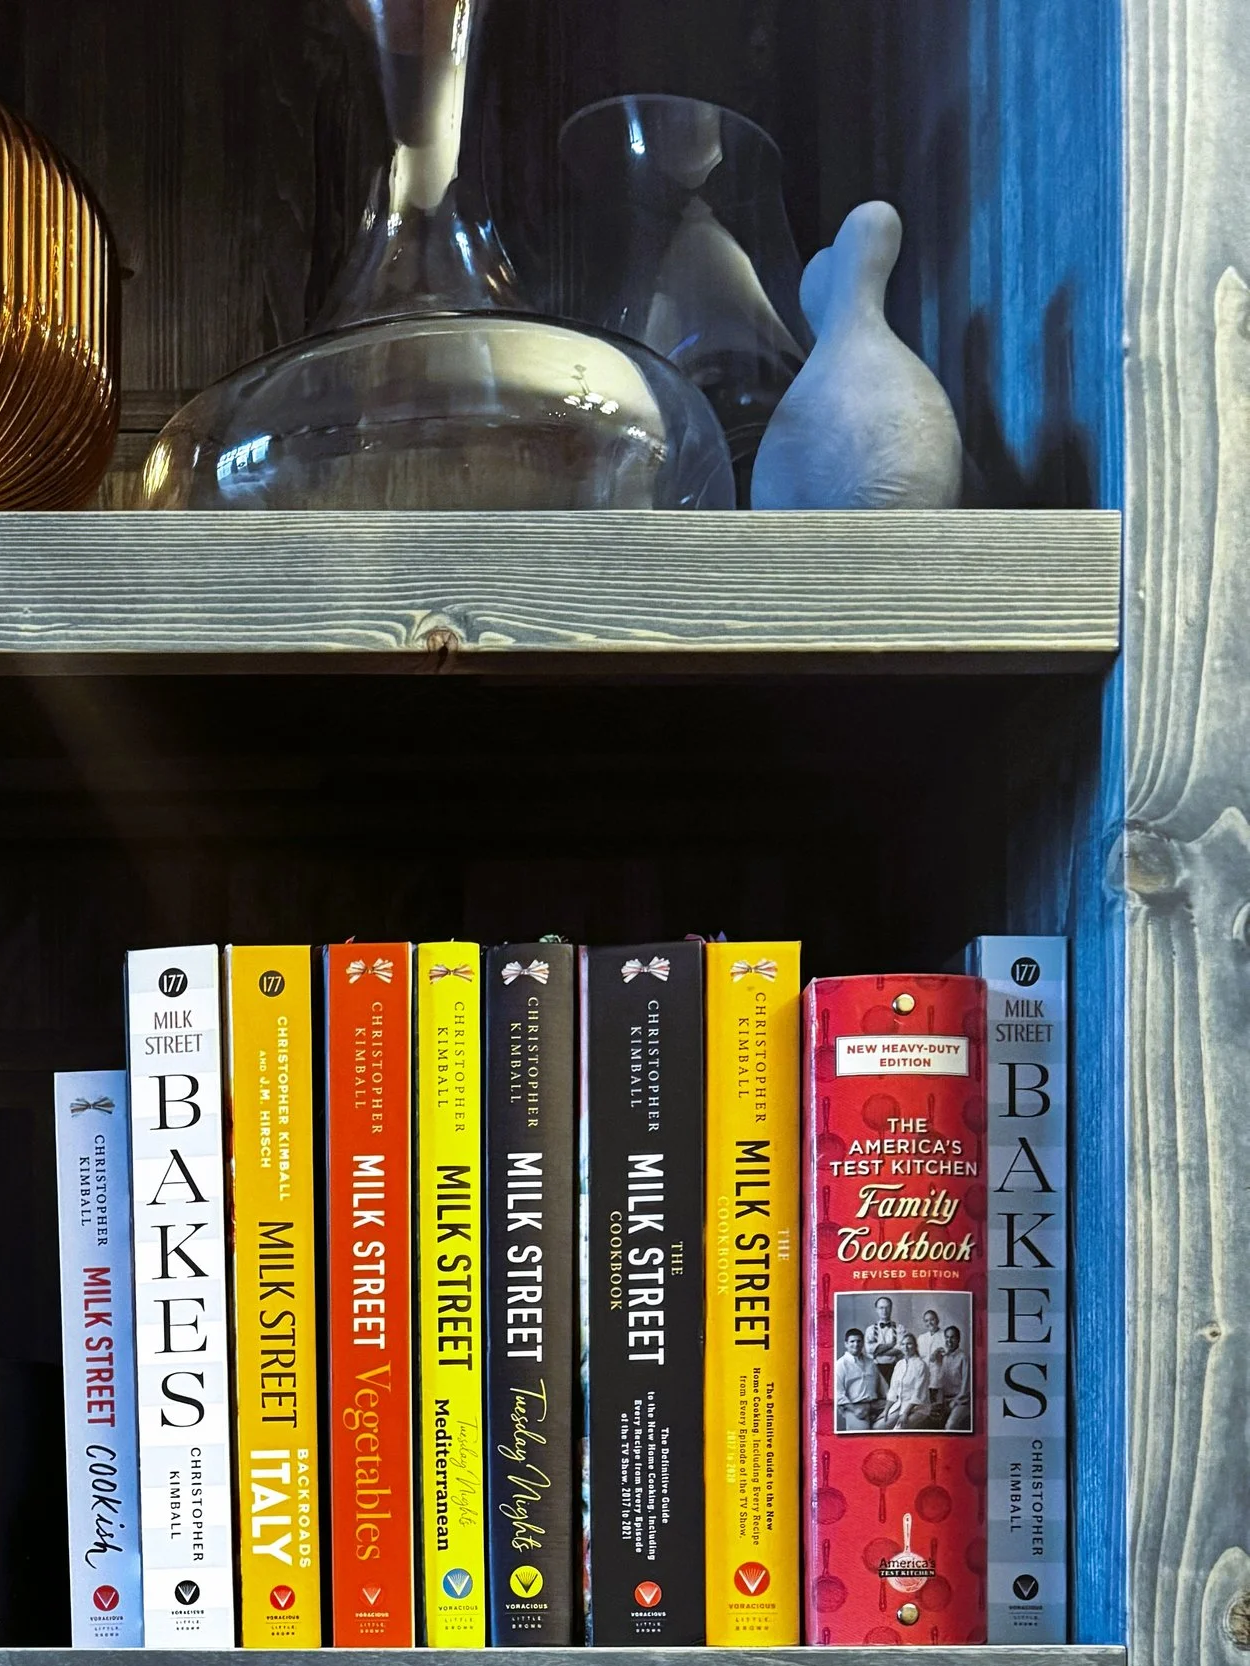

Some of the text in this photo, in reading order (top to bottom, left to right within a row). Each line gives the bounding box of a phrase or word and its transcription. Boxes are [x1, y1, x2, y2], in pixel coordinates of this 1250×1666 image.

[145, 1034, 202, 1055] STREET
[154, 1010, 192, 1030] MILK
[847, 1044, 960, 1055] NEW HEAVY-DUTY
[995, 1023, 1054, 1043] STREET
[1005, 999, 1044, 1018] MILK
[630, 1026, 642, 1108] KIMBALL
[648, 1000, 660, 1132] CHRISTOPHER
[879, 1057, 931, 1068] EDITION
[277, 1016, 291, 1201] CHRISTOPHER KIMBALL
[849, 1140, 962, 1155] AMERICA'S
[887, 1118, 927, 1133] THE
[79, 1156, 91, 1227] KIMBALL
[94, 1135, 108, 1246] CHRISTOPHER
[829, 1160, 978, 1177] TEST KITCHEN
[855, 1183, 959, 1225] Family
[146, 1074, 210, 1428] BAKES
[437, 1165, 473, 1371] MILK STREET
[506, 1152, 543, 1362] MILK STREET
[627, 1153, 665, 1366] MILK STREET
[837, 1226, 976, 1261] Cookbook
[853, 1269, 960, 1280] REVISED EDITION
[993, 1062, 1057, 1420] BAKES
[82, 1267, 112, 1328] MILK
[258, 1221, 297, 1428] MILK STREET
[85, 1336, 116, 1427] STREET
[343, 1154, 392, 1561] MILK STREET Vegetables
[250, 1449, 293, 1565] ITALY
[297, 1448, 312, 1569] BACKROADS
[435, 1398, 450, 1551] Mediterranean
[497, 1378, 551, 1553] Tuesday Nights
